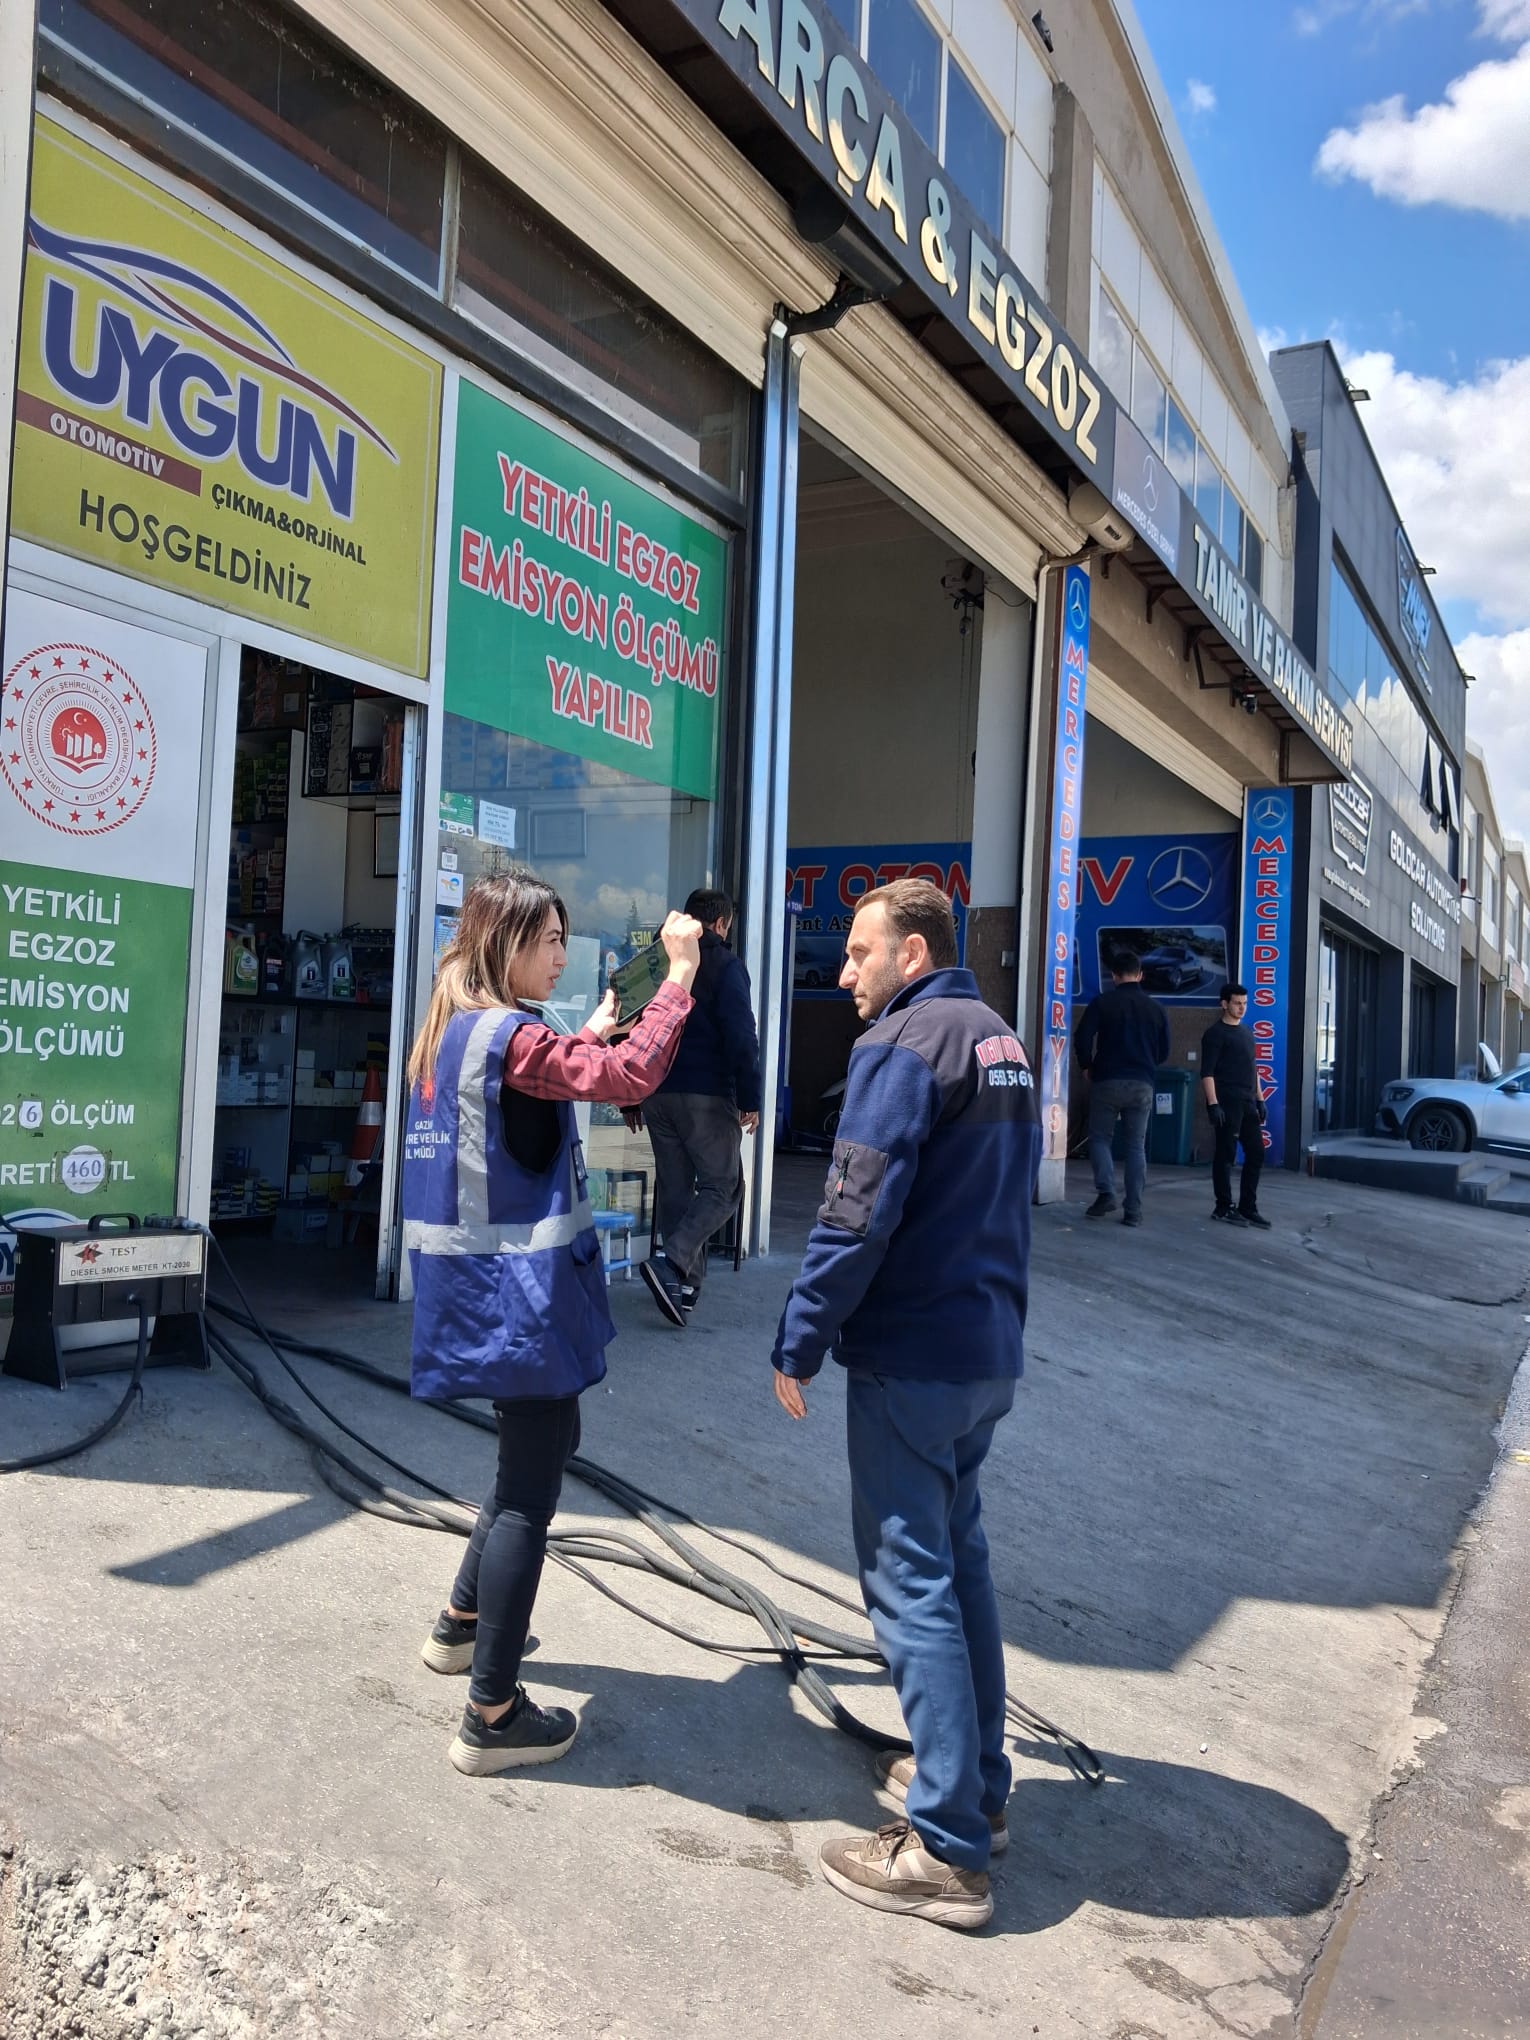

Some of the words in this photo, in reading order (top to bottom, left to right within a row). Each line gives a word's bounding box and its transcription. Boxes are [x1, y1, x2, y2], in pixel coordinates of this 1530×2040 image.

[920, 178, 958, 298] &
[968, 229, 1100, 466] EGZOZ
[45, 275, 356, 520] UYGUN
[50, 412, 165, 478] OTOMOTİV
[79, 489, 312, 610] HOŞGELDİNİZ
[211, 483, 366, 565] ÇIKMA&ORJİNAL
[497, 451, 610, 566] YETKİLİ
[615, 519, 700, 614] EGZOZ
[459, 525, 608, 650] EMİSYON
[612, 593, 719, 697] ÖLÇÜMÜ
[1194, 523, 1247, 648] TAMİR
[1251, 602, 1273, 676] VE
[1272, 633, 1315, 727] BAKIM
[1313, 691, 1353, 770] SERVİSİ
[546, 656, 654, 750] YAPILIR
[1057, 637, 1085, 911] MERCEDES
[1390, 829, 1426, 889] GOLDCAR
[2, 884, 121, 925] YETKİLİ
[9, 930, 116, 967] EGZOZ
[1251, 835, 1287, 1007] MERCEDES
[1411, 901, 1446, 952] SOLUTIONS
[1048, 932, 1068, 1133] SERVİS
[50, 1099, 135, 1129] ÖLÇÜM
[67, 1159, 101, 1178] 460
[110, 1160, 135, 1180] TL
[70, 1268, 100, 1277] DIESEL
[101, 1266, 129, 1275] SMOKE
[132, 1263, 158, 1272] METER
[110, 1246, 137, 1257] TEST
